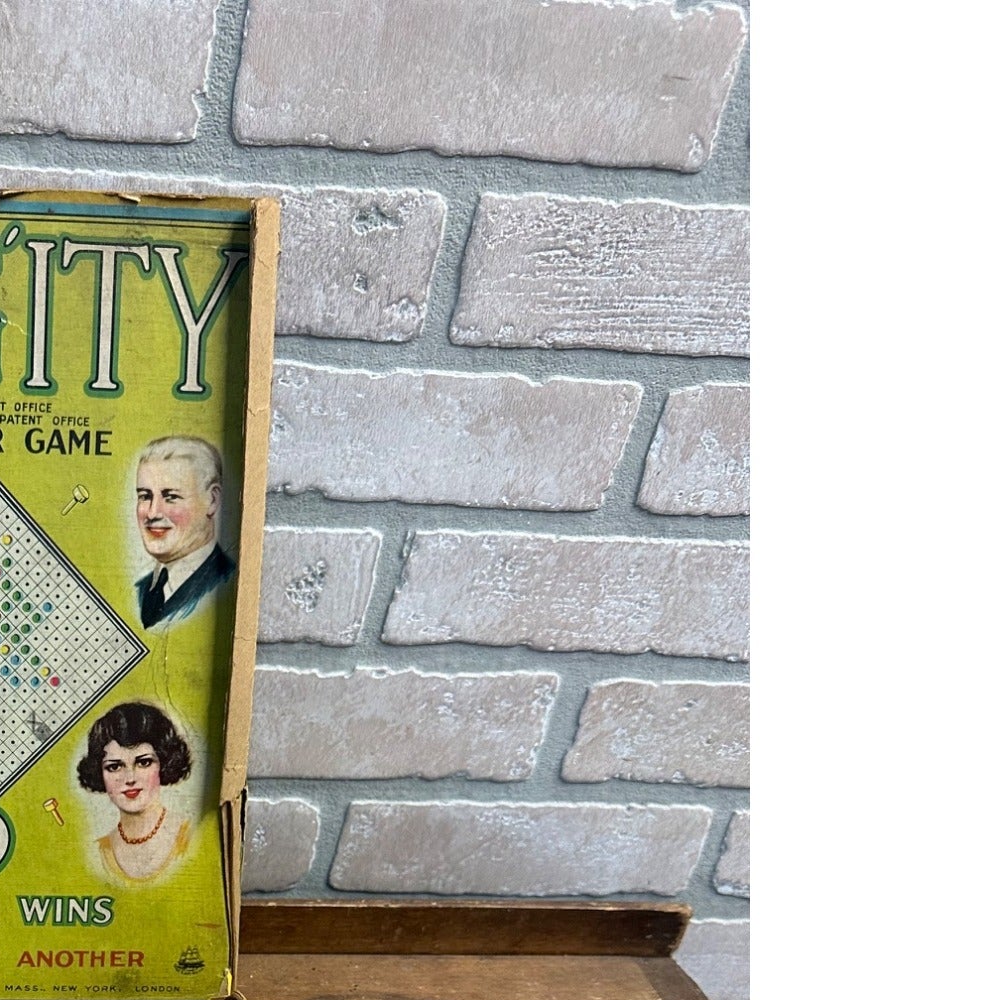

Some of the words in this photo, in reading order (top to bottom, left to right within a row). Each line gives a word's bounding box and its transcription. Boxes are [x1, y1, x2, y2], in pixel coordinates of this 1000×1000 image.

[14, 403, 52, 413] OFFICE
[0, 415, 42, 425] PATENT
[52, 416, 90, 427] OFFICE
[25, 427, 112, 456] GAME
[17, 895, 114, 926] WINS
[16, 950, 145, 969] ANOTHER
[53, 984, 78, 993] NEW
[134, 985, 181, 993] LONDON
